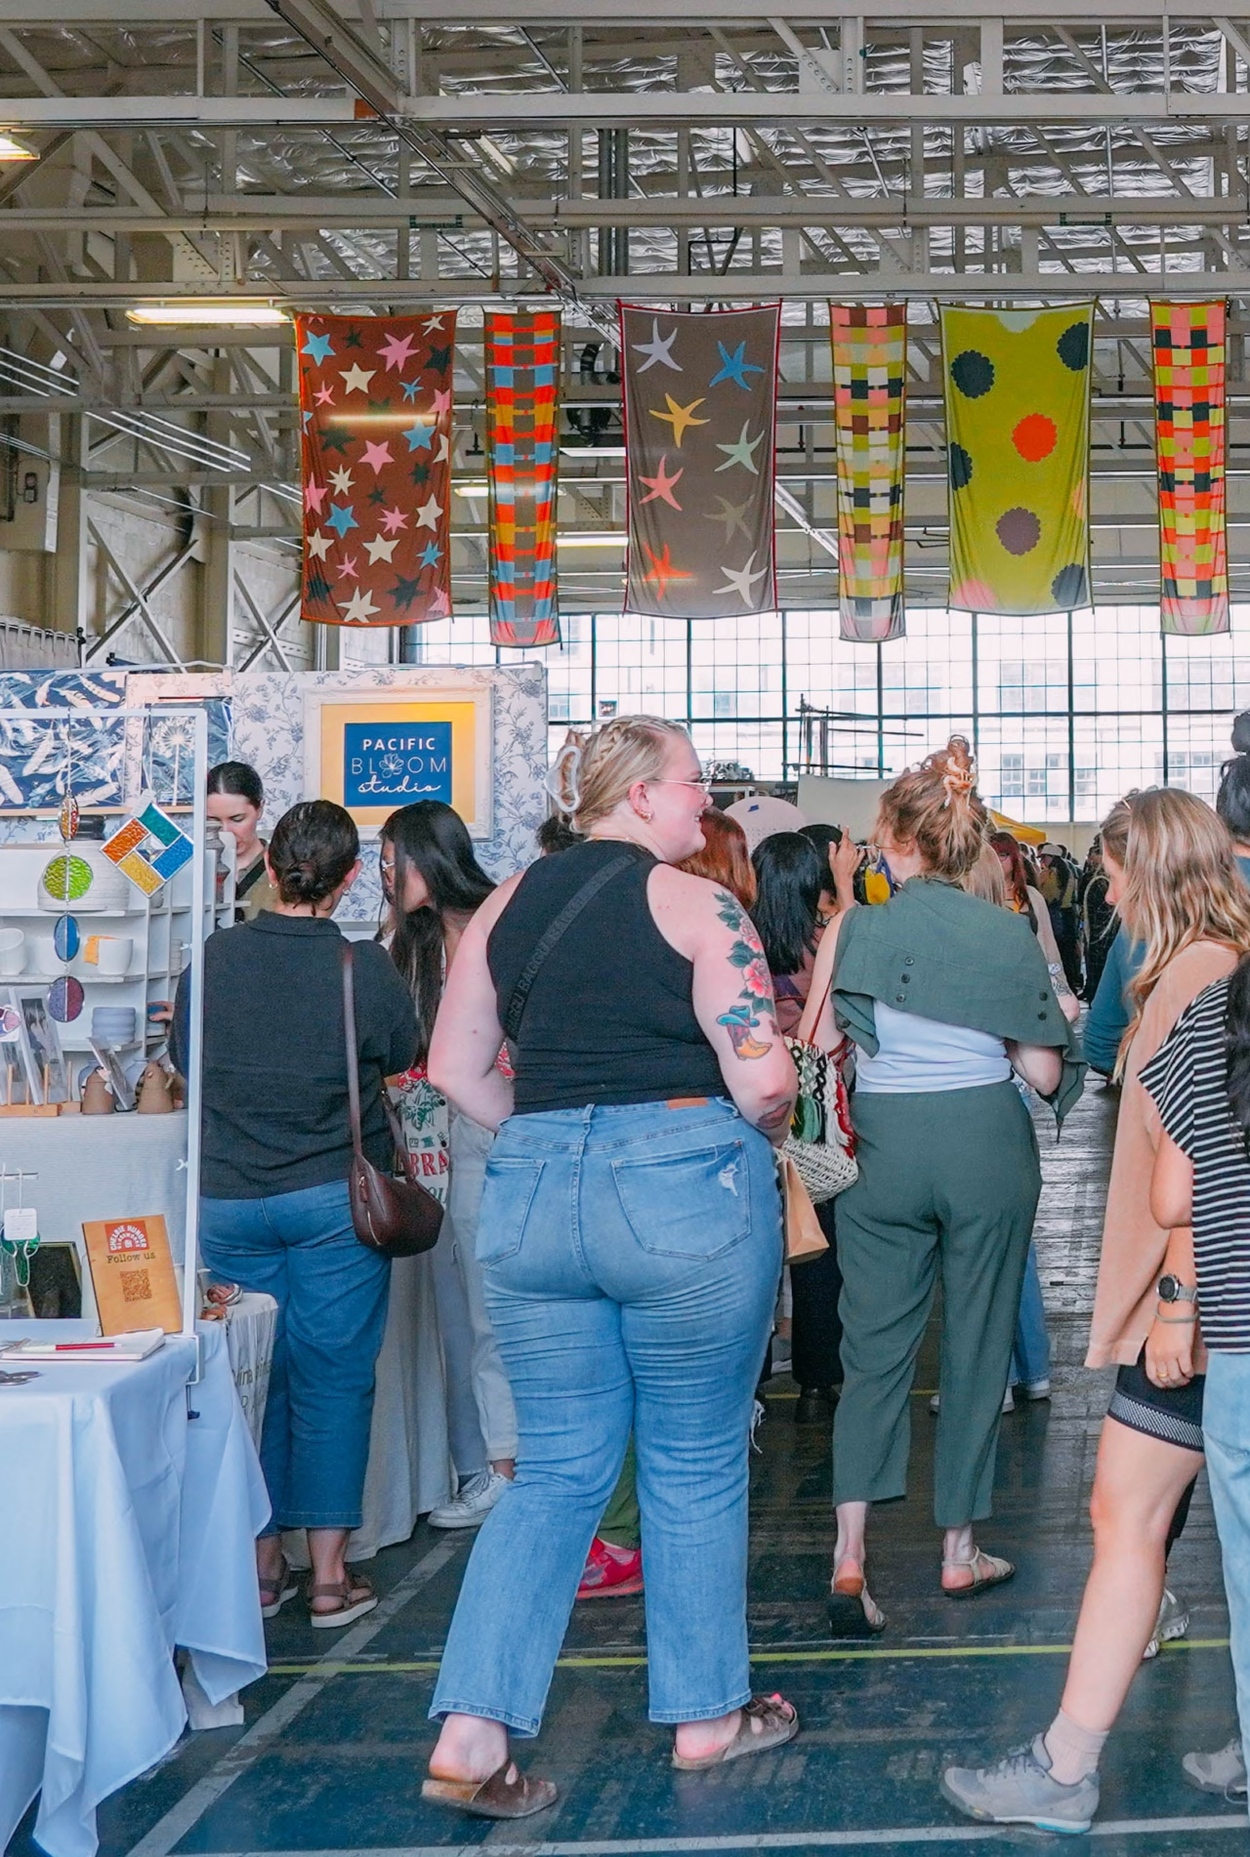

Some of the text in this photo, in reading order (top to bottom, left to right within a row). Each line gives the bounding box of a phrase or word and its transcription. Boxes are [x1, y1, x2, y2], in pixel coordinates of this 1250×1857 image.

[363, 738, 435, 751] PACIFIC
[358, 775, 441, 794] studio
[515, 939, 551, 992] BAGGU
[107, 1252, 156, 1264] Follow us
